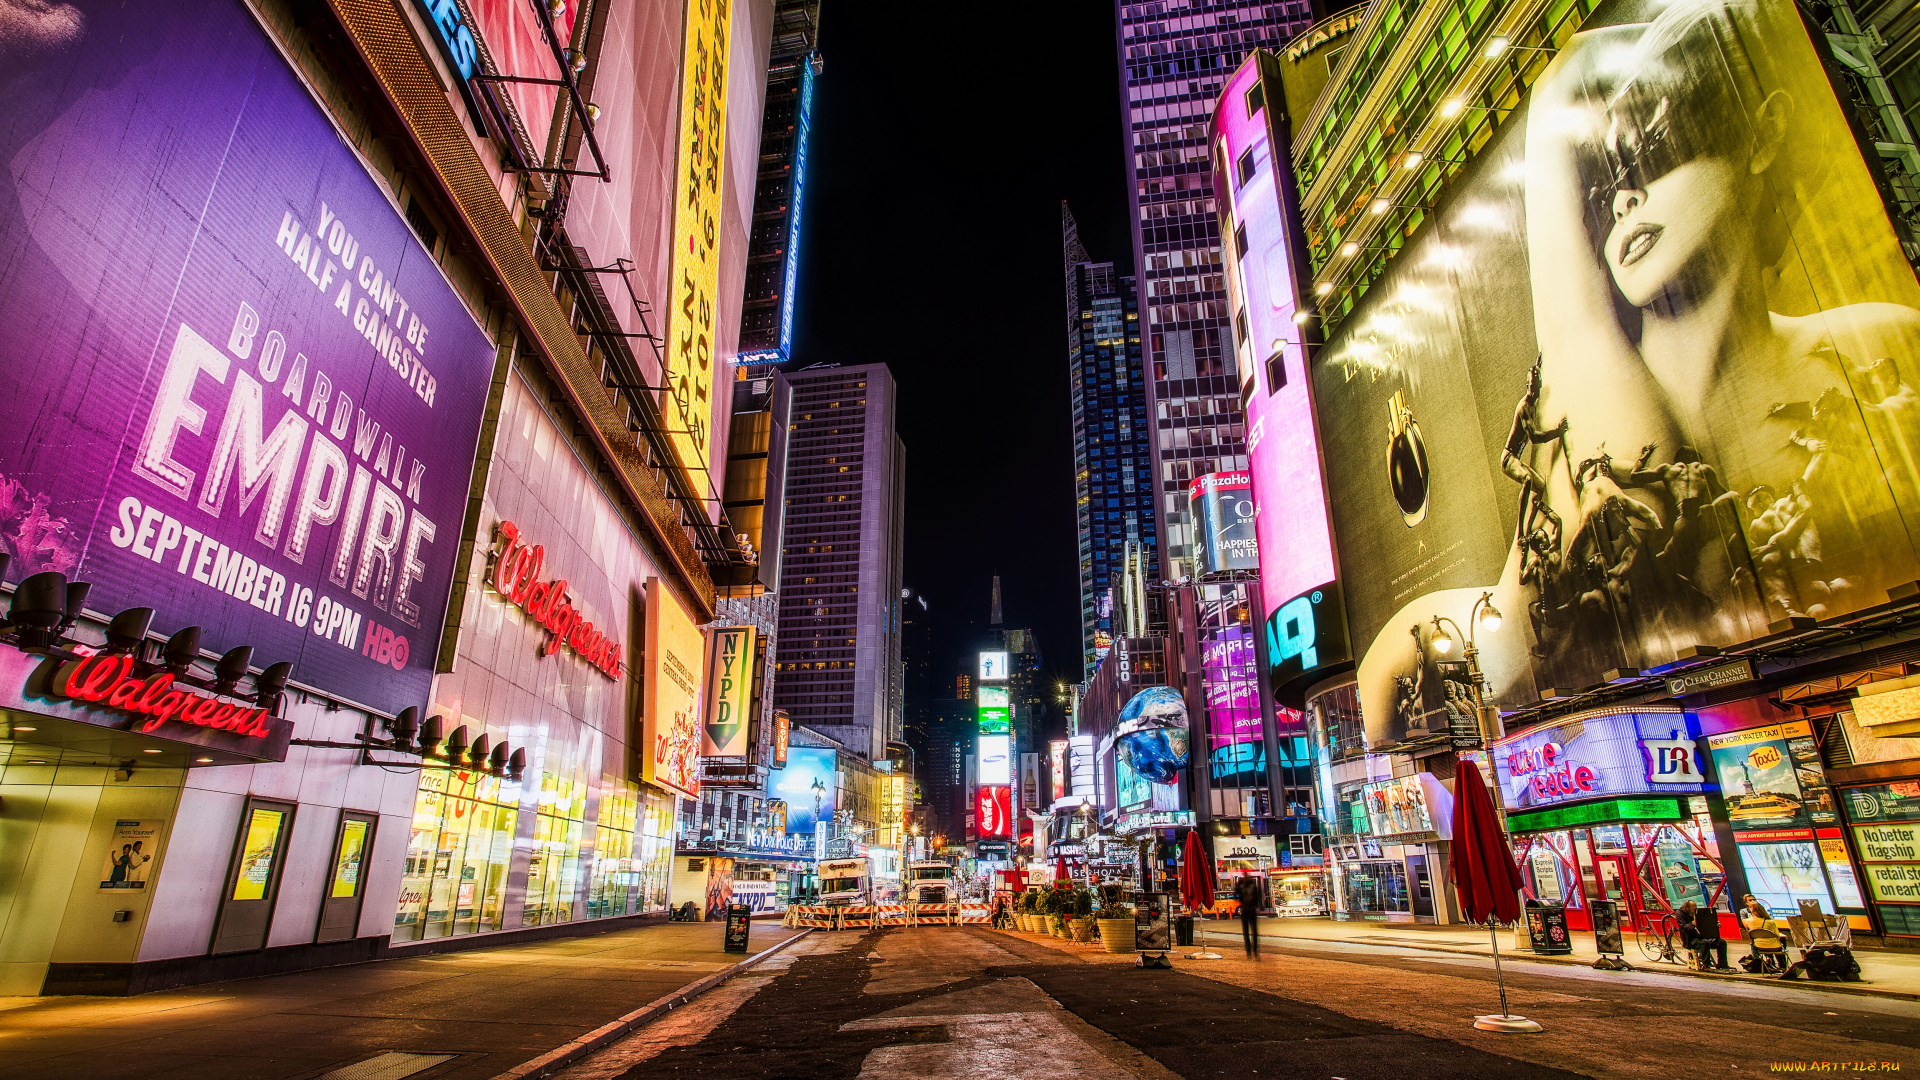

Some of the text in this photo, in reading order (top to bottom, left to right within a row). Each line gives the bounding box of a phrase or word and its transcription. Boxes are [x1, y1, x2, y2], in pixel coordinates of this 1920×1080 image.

[688, 28, 708, 224] PARK
[798, 128, 808, 165] PLAY
[316, 201, 429, 356] YOU CAN'T BE
[275, 211, 437, 408] HALF A GANGSTER
[678, 268, 696, 421] NYC
[693, 290, 711, 450] 2012
[227, 300, 426, 504] BOARDWALK
[131, 322, 436, 628] EMPIRE
[1232, 549, 1244, 558] IN
[1419, 558, 1431, 569] BLACK
[110, 496, 362, 650] SEPTEMBER 16 9PM
[499, 521, 621, 682] Walgreens
[362, 620, 410, 670] HBO
[1120, 640, 1130, 681] 1500
[65, 644, 269, 738] Walgreens
[717, 634, 738, 723] NYPD
[1709, 673, 1748, 687] SPECTACOLOR
[1711, 737, 1724, 746] NEW
[1725, 734, 1741, 743] YORK
[1742, 731, 1763, 740] WATER
[1764, 728, 1779, 737] TAXI
[1508, 743, 1556, 776] duane
[1657, 747, 1691, 775] DR
[1748, 745, 1780, 768] Taxi!
[1529, 760, 1594, 799] reade
[1883, 805, 1920, 814] Organization
[747, 828, 761, 847] NEW
[761, 829, 776, 848] YORK
[776, 831, 794, 850] POLICE
[1232, 847, 1257, 855] 1500
[1863, 828, 1914, 842] No better
[1867, 844, 1915, 860] flagship
[1875, 866, 1905, 880] retail
[1881, 884, 1896, 896] on
[738, 893, 766, 912] NYPD
